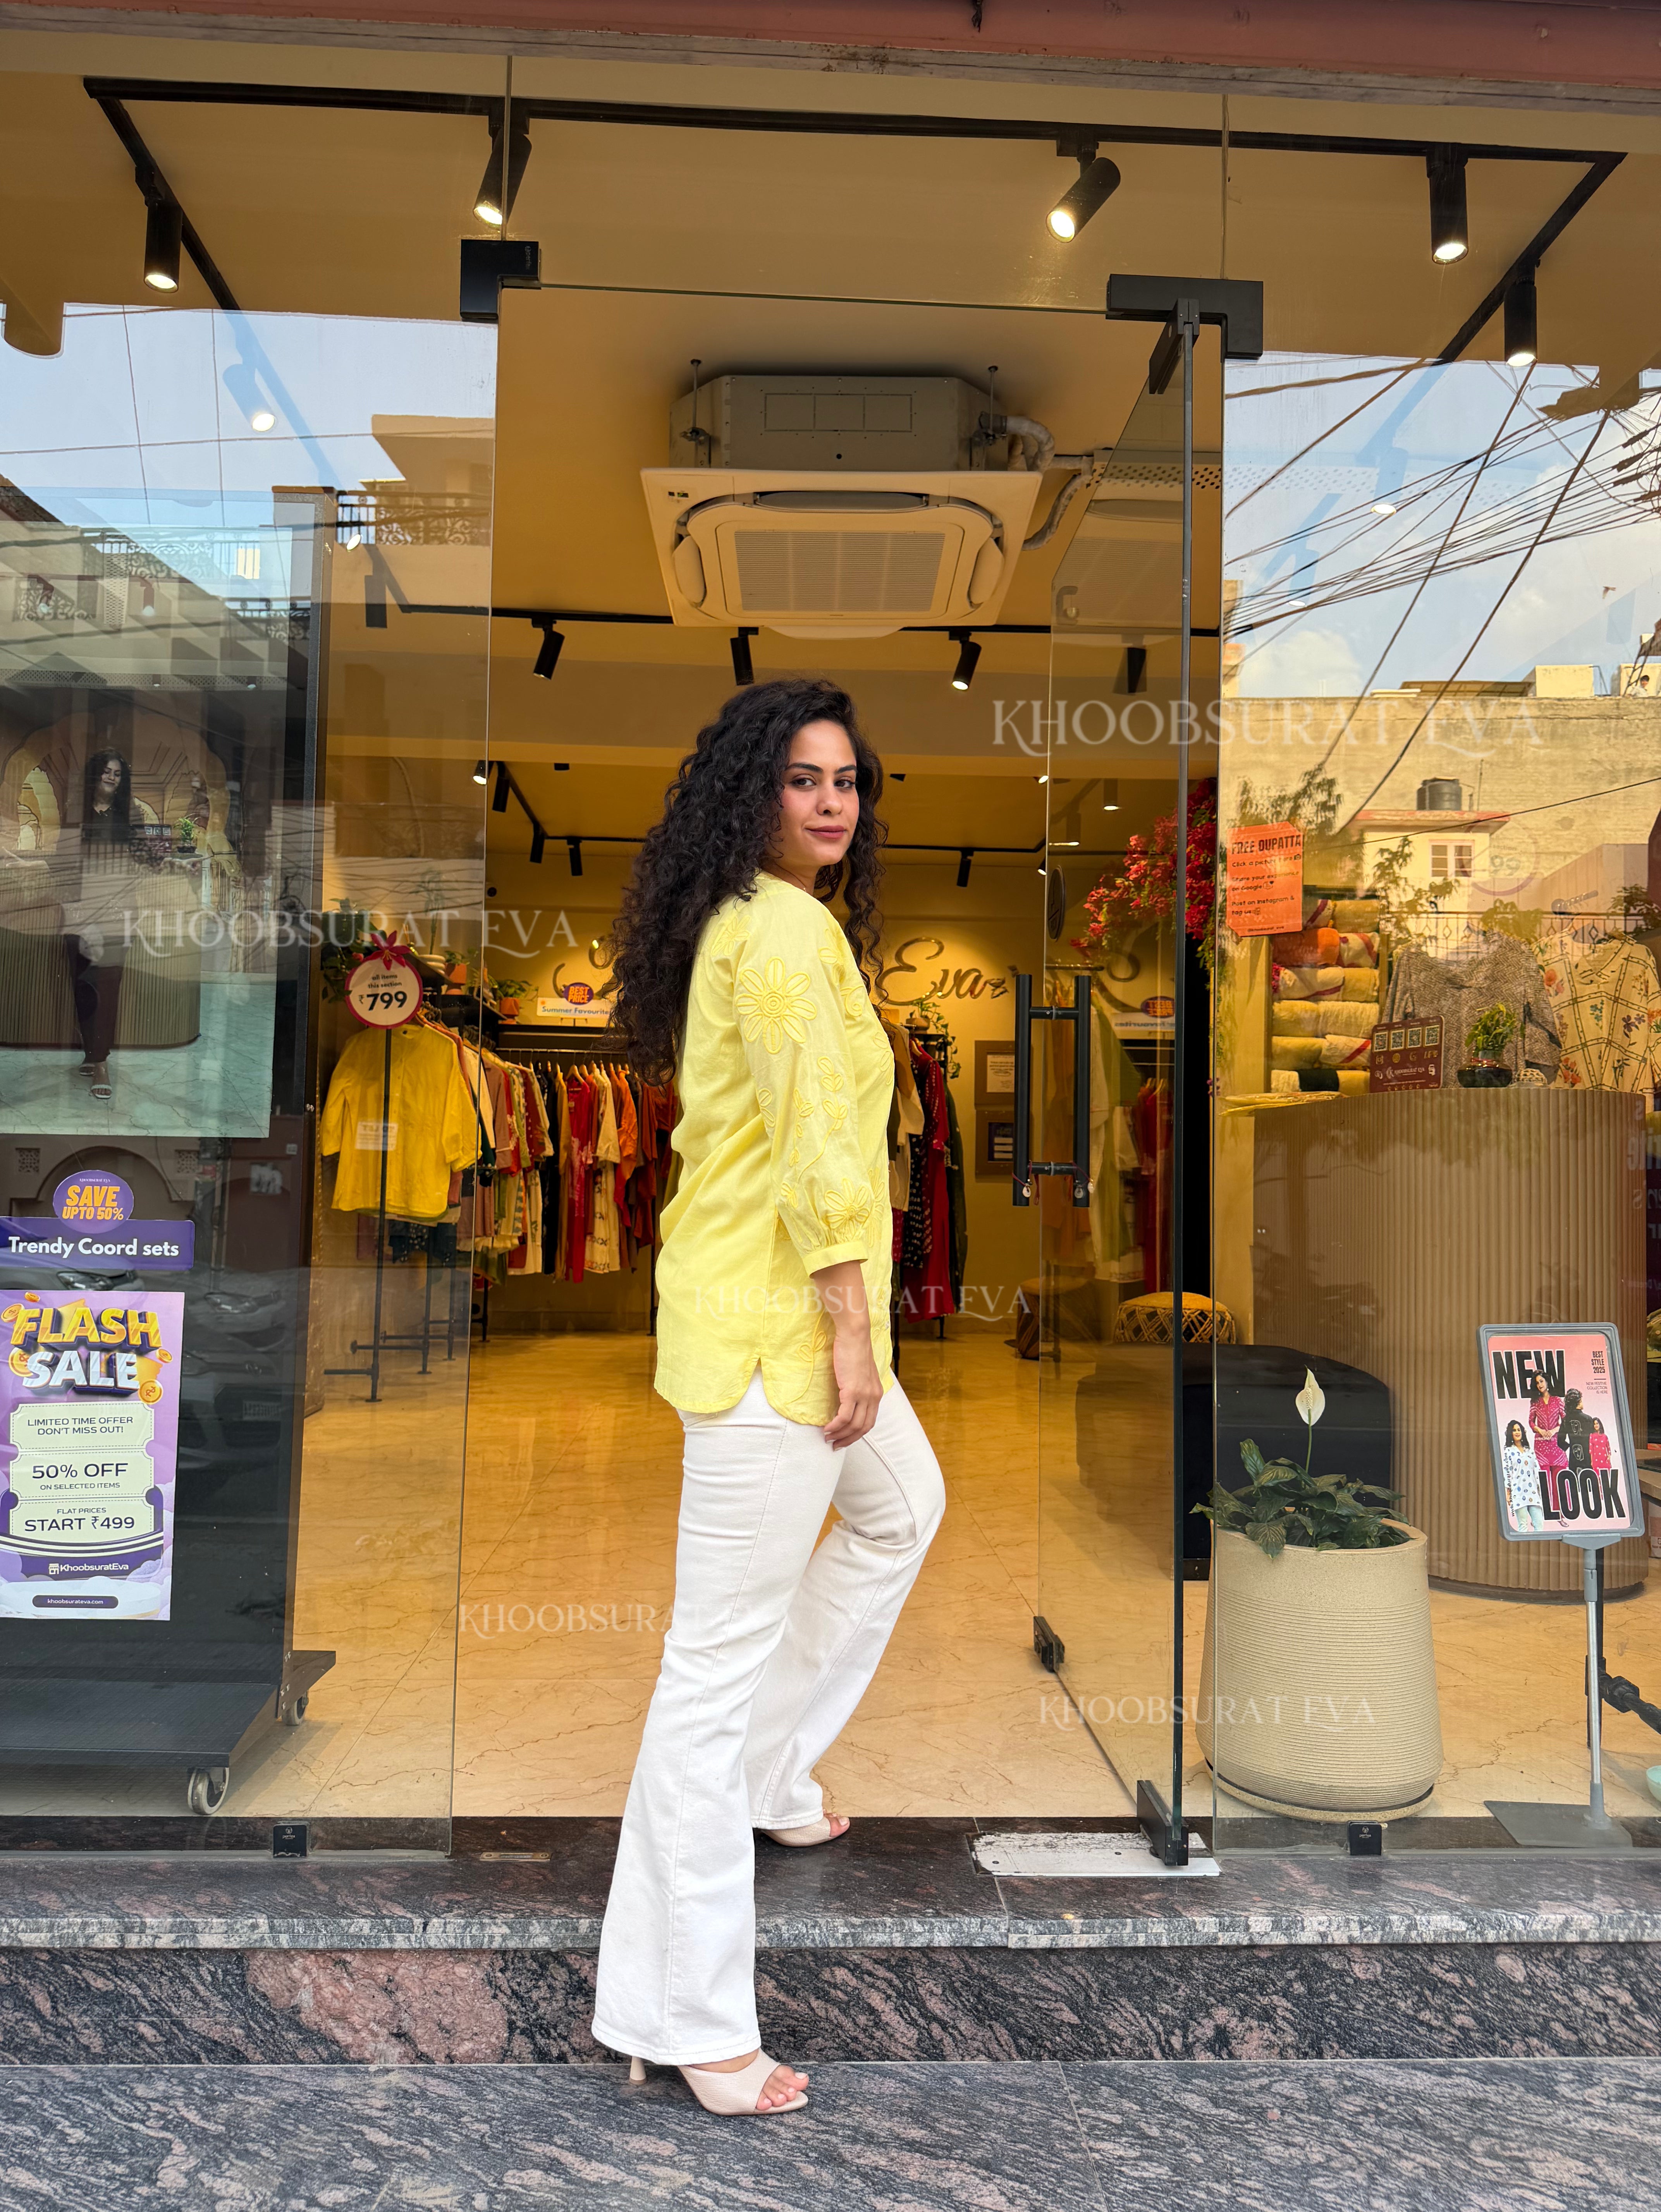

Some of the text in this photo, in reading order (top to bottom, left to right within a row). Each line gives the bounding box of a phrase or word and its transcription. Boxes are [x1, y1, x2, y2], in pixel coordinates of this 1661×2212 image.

[1259, 835, 1301, 852] DUPATTA
[568, 994, 590, 1003] PRICE
[569, 986, 590, 995] BEST
[574, 1007, 610, 1015] Favourite
[66, 1185, 120, 1207] SAVE
[96, 1207, 124, 1220] 50%
[9, 1236, 179, 1258] Trendy Coord sets
[10, 1307, 163, 1350] FLASH
[22, 1350, 140, 1390] SALE
[1491, 1350, 1566, 1399] NEW
[28, 1418, 69, 1427] LIMITED
[98, 1416, 133, 1424] OFFER
[38, 1427, 69, 1436] DON'T
[32, 1463, 128, 1479] 50% OFF
[1538, 1468, 1627, 1521] LOOK
[24, 1516, 135, 1532] START ₹499
[60, 1563, 129, 1572] KhoobsuratEva
